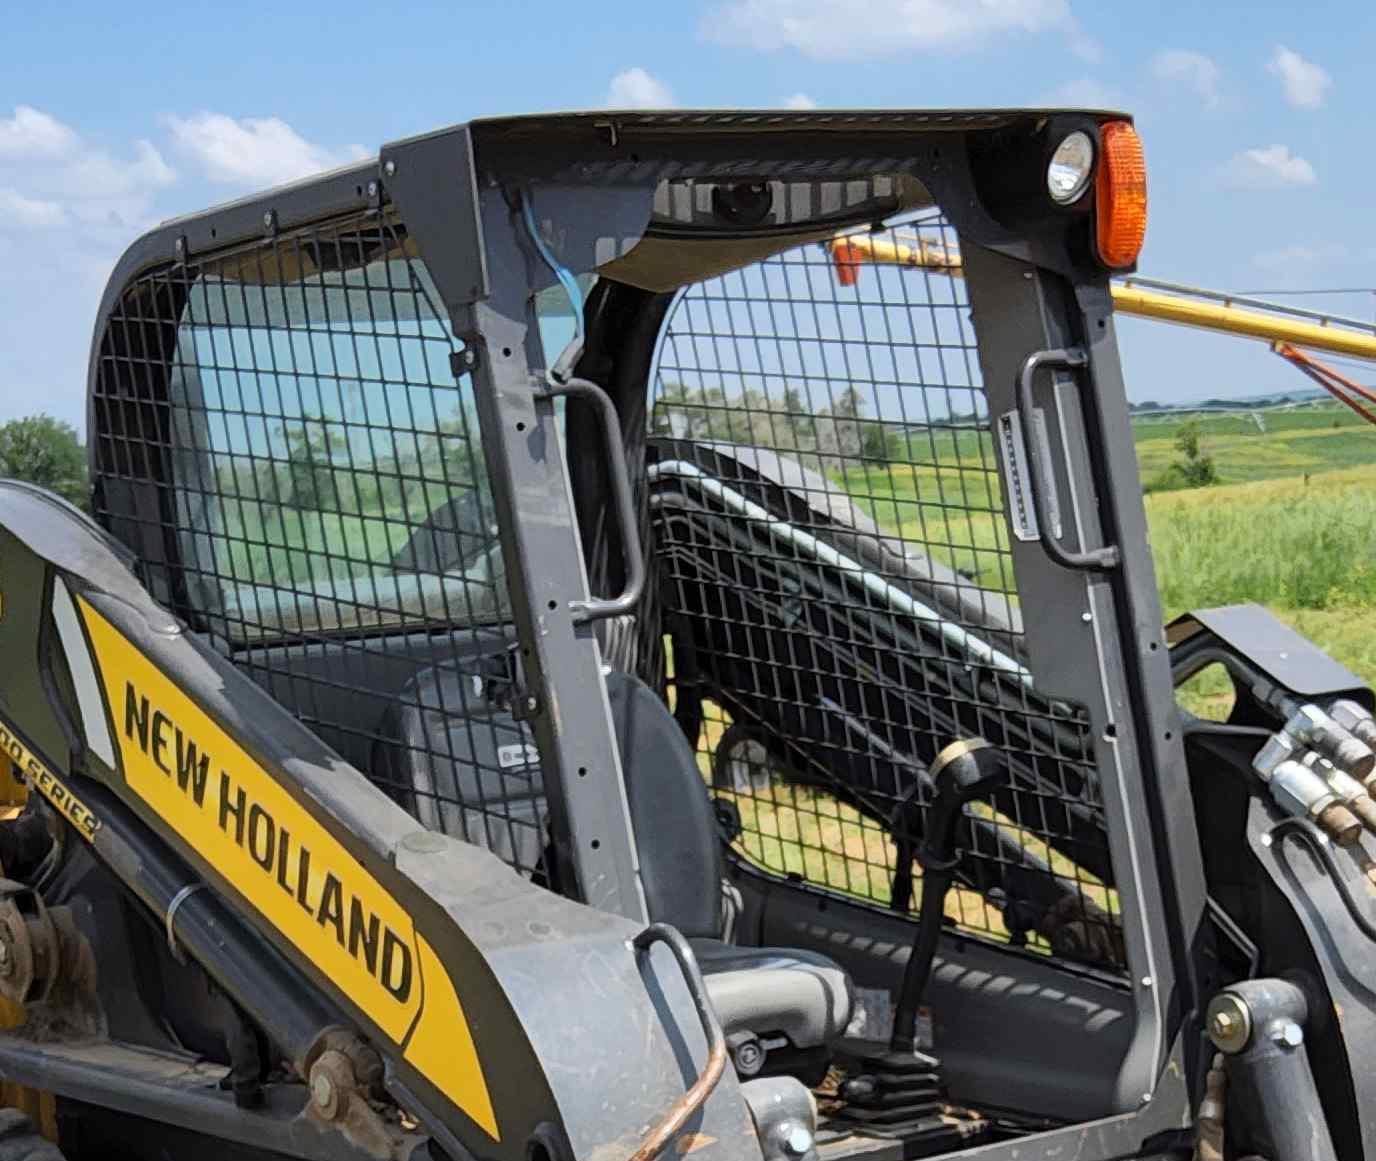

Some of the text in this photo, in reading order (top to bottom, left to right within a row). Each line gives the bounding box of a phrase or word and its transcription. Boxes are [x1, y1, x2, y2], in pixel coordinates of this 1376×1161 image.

[27, 757, 99, 835] SERIES
[125, 679, 414, 1005] NEW HOLLAND
